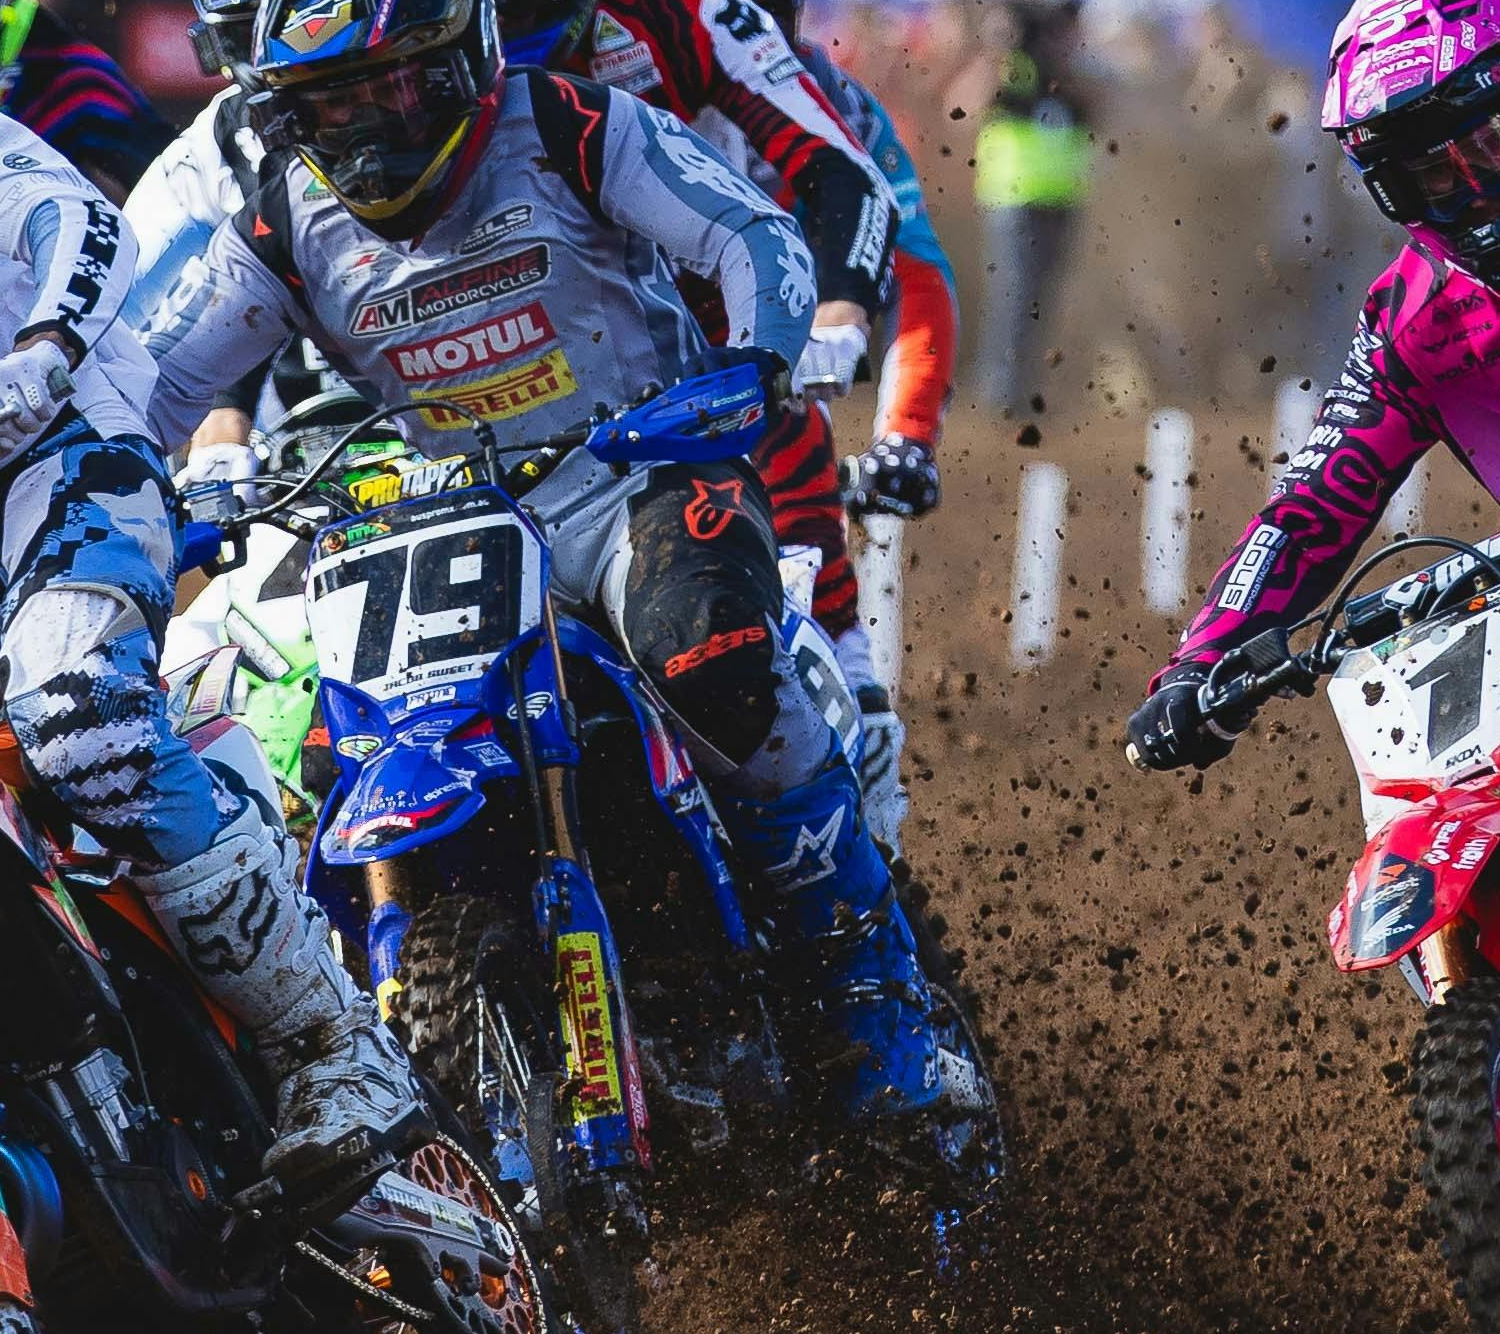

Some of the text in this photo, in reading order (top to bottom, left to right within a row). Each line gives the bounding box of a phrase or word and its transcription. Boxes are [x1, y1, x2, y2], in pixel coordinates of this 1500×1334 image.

[1372, 180, 1397, 214] OAKLEY
[416, 266, 543, 320] MOTORCYCLES
[418, 249, 542, 308] ALPINE
[397, 311, 546, 378] MOTUL
[313, 523, 523, 685] 79
[1405, 616, 1488, 761] 1
[558, 947, 612, 1103] PIRELLI
[336, 1129, 372, 1162] FOX
